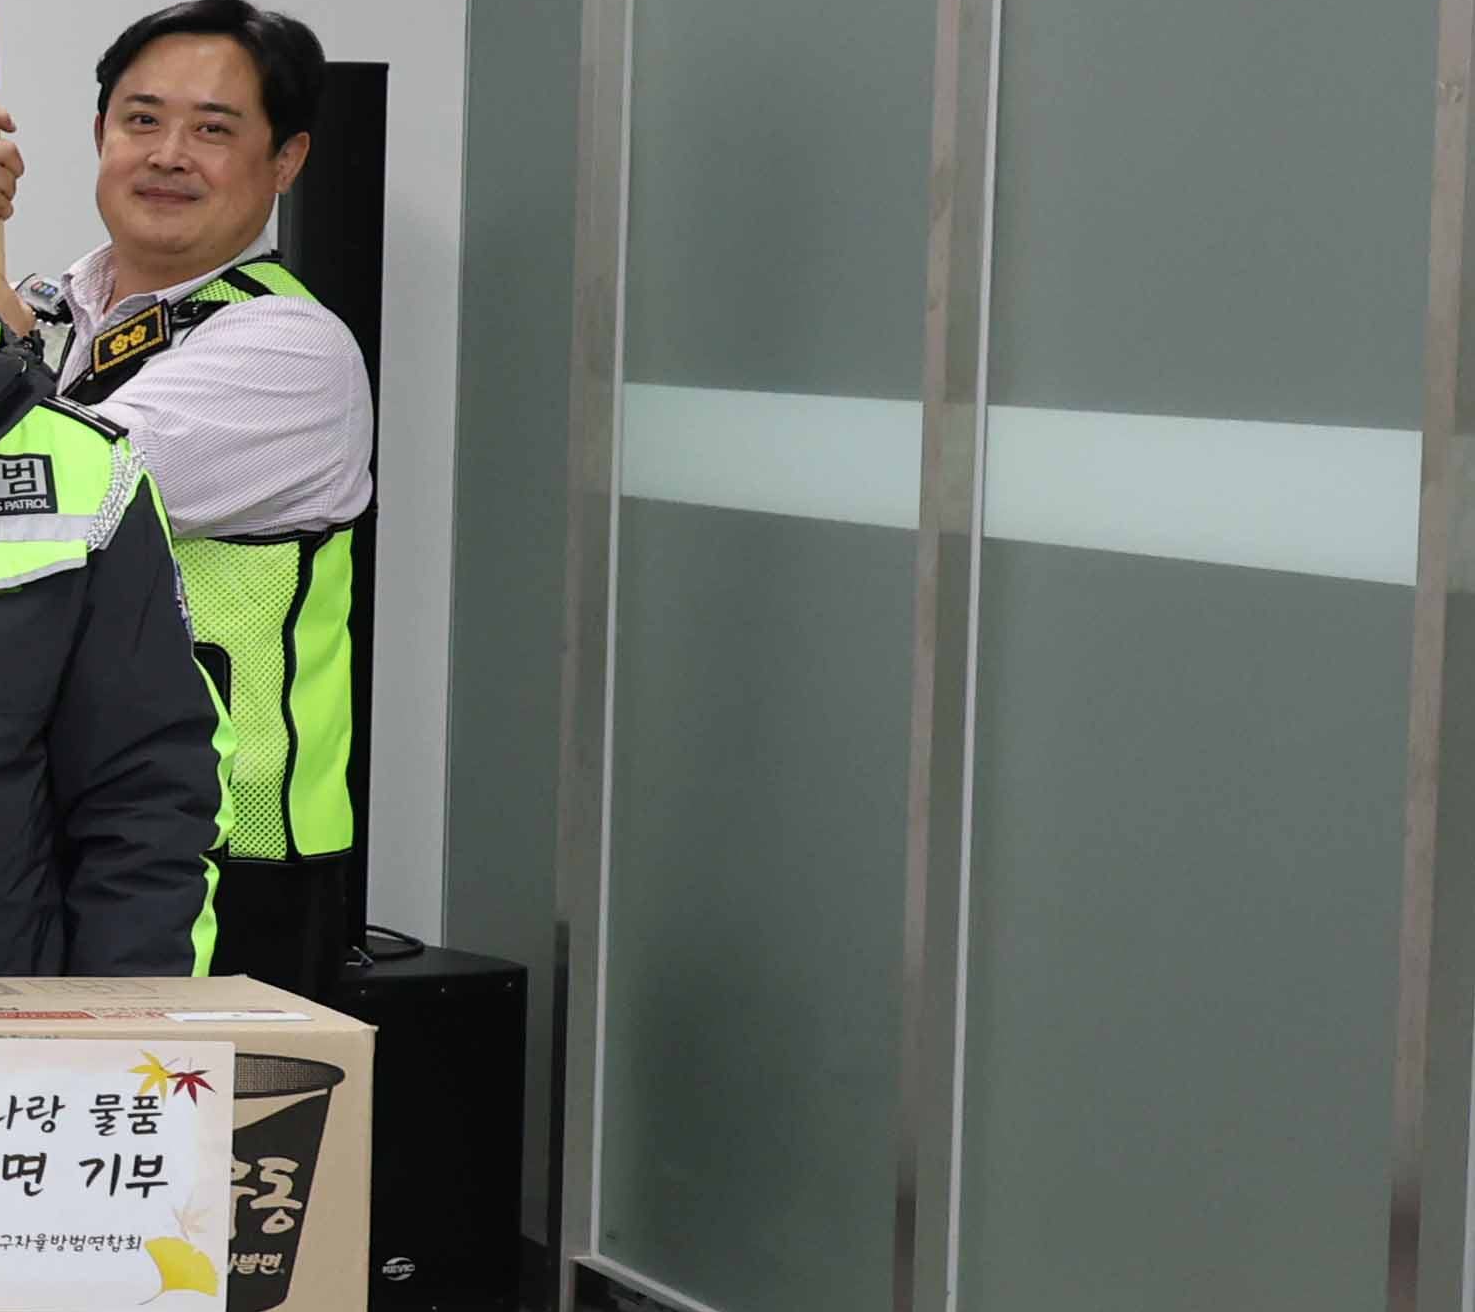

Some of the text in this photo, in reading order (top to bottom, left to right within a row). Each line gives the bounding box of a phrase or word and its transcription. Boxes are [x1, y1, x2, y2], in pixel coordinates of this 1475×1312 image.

[4, 497, 52, 510] PATROL
[89, 1093, 163, 1137] 물품
[78, 1153, 169, 1199] 기부
